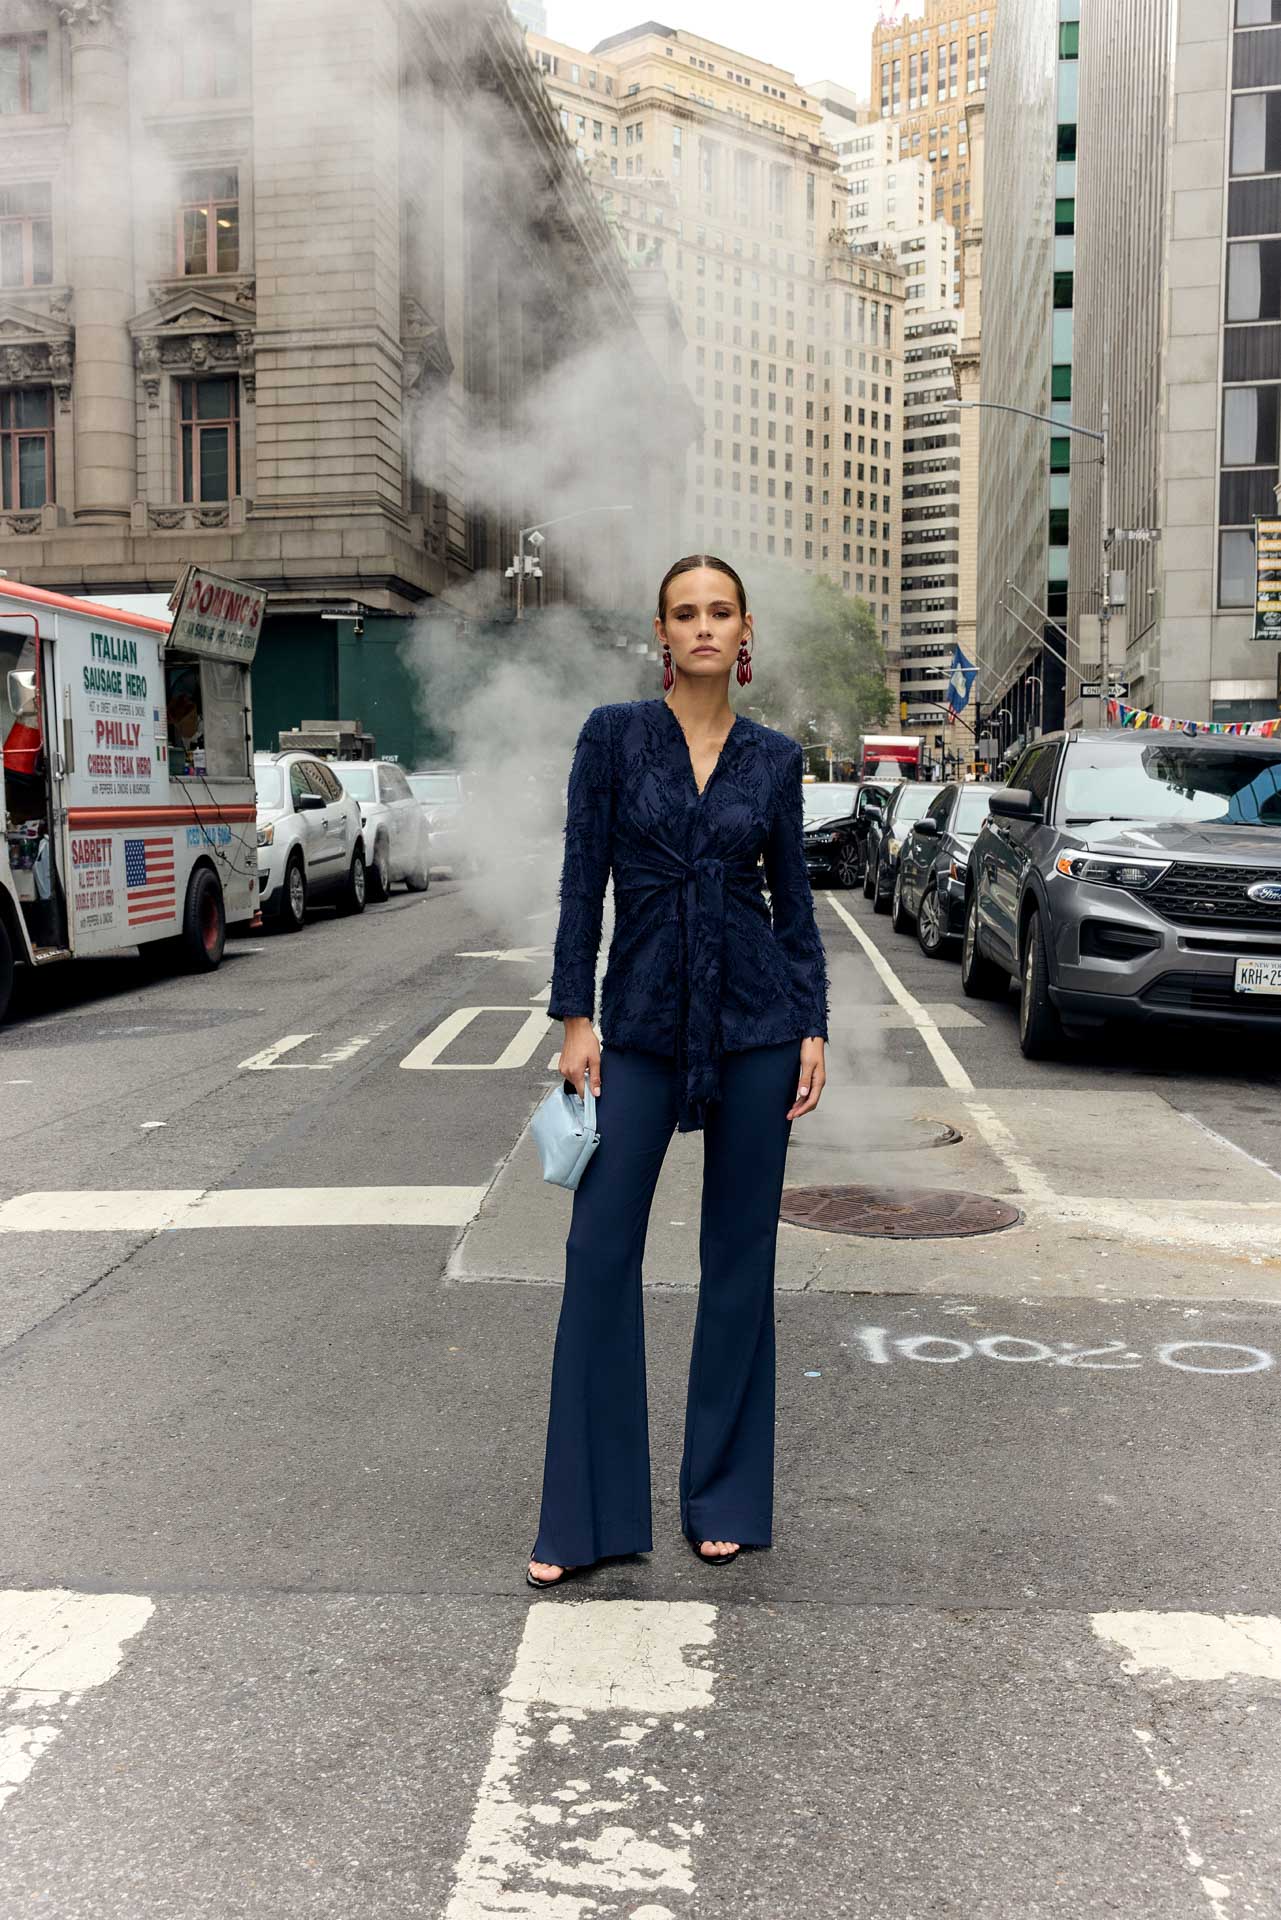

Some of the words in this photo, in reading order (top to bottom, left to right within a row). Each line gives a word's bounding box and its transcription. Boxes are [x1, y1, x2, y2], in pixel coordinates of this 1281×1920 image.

[91, 632, 138, 665] ITALIAN
[83, 665, 123, 695] SAUSAGE
[125, 672, 147, 698] HERO
[96, 719, 141, 748] PHILLY
[88, 753, 113, 775] CHEESE
[114, 755, 135, 776] STEAK
[136, 756, 152, 778] HERO
[72, 838, 113, 865] SABRETT
